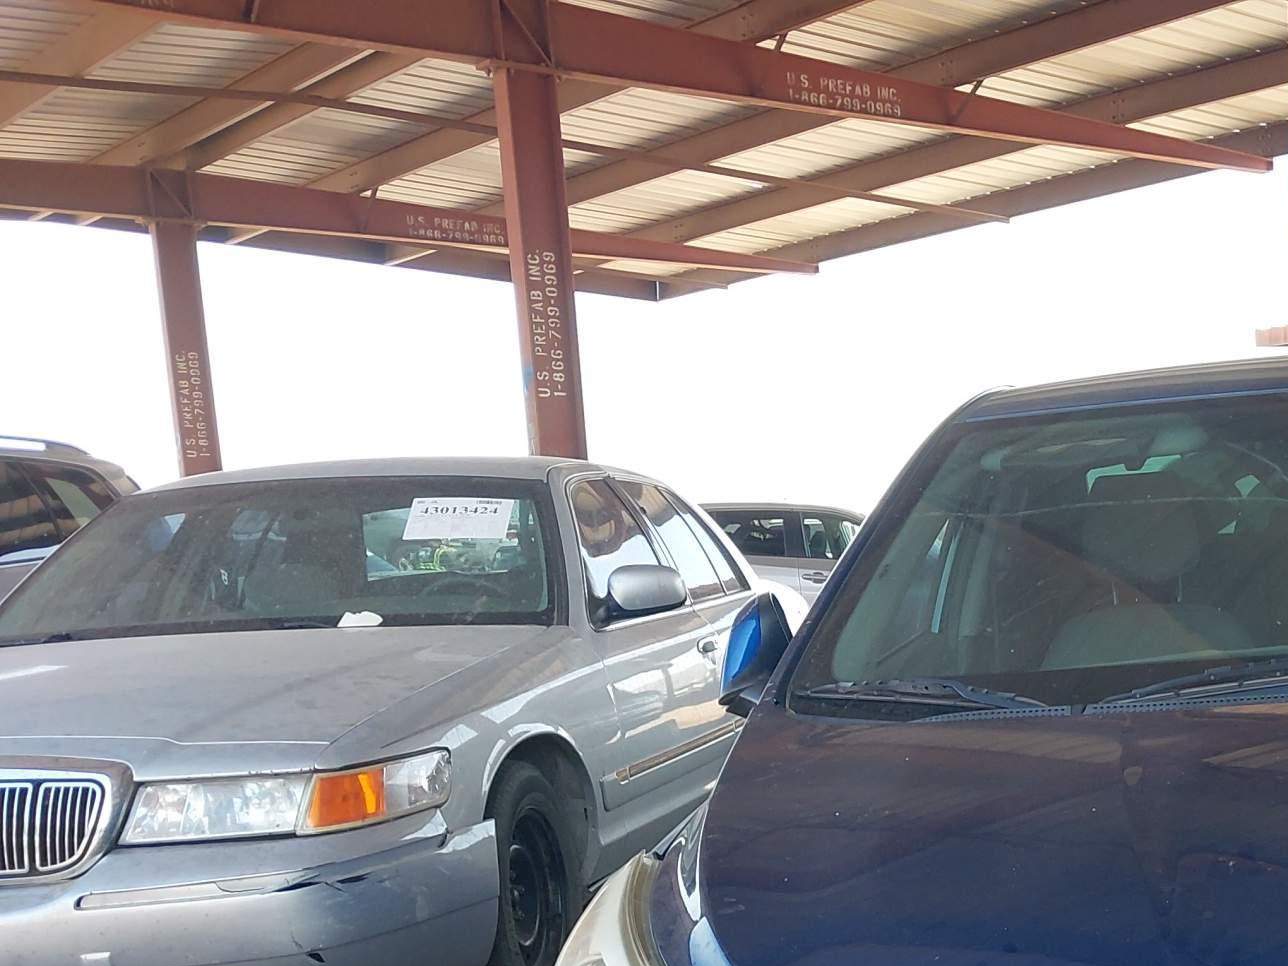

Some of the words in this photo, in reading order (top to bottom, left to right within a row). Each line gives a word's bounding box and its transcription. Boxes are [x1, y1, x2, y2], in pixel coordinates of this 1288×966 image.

[789, 88, 902, 118] 1-866-799-0969
[819, 77, 871, 97] PREFAB
[526, 249, 542, 281] INC.
[529, 289, 548, 357] PREFAB
[542, 251, 567, 397] 1-866-799-0969
[178, 380, 195, 428] PREFAB
[418, 505, 499, 515] 43013424
